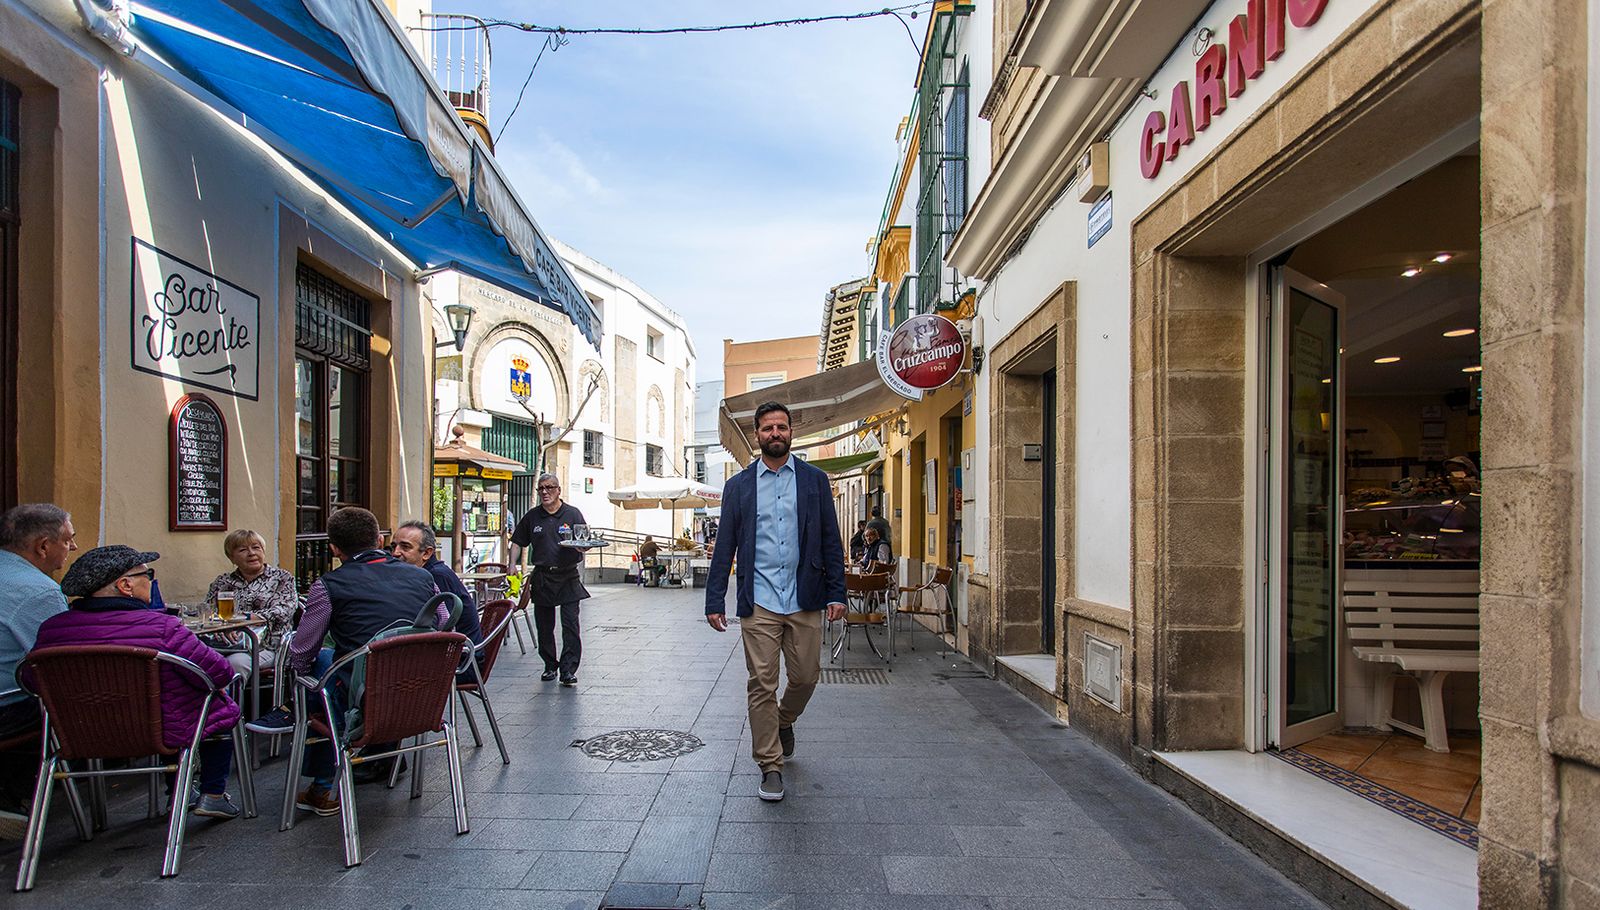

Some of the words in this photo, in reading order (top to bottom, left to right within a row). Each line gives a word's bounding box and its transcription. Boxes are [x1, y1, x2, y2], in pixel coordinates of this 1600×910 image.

[154, 273, 226, 316] Bar
[477, 287, 506, 304] MERCADO
[508, 300, 517, 309] DE
[569, 291, 591, 331] VICENTE
[142, 315, 251, 361] Vicente
[894, 343, 961, 372] Cruzcampo
[882, 366, 888, 374] EL
[886, 374, 912, 394] MERCADO
